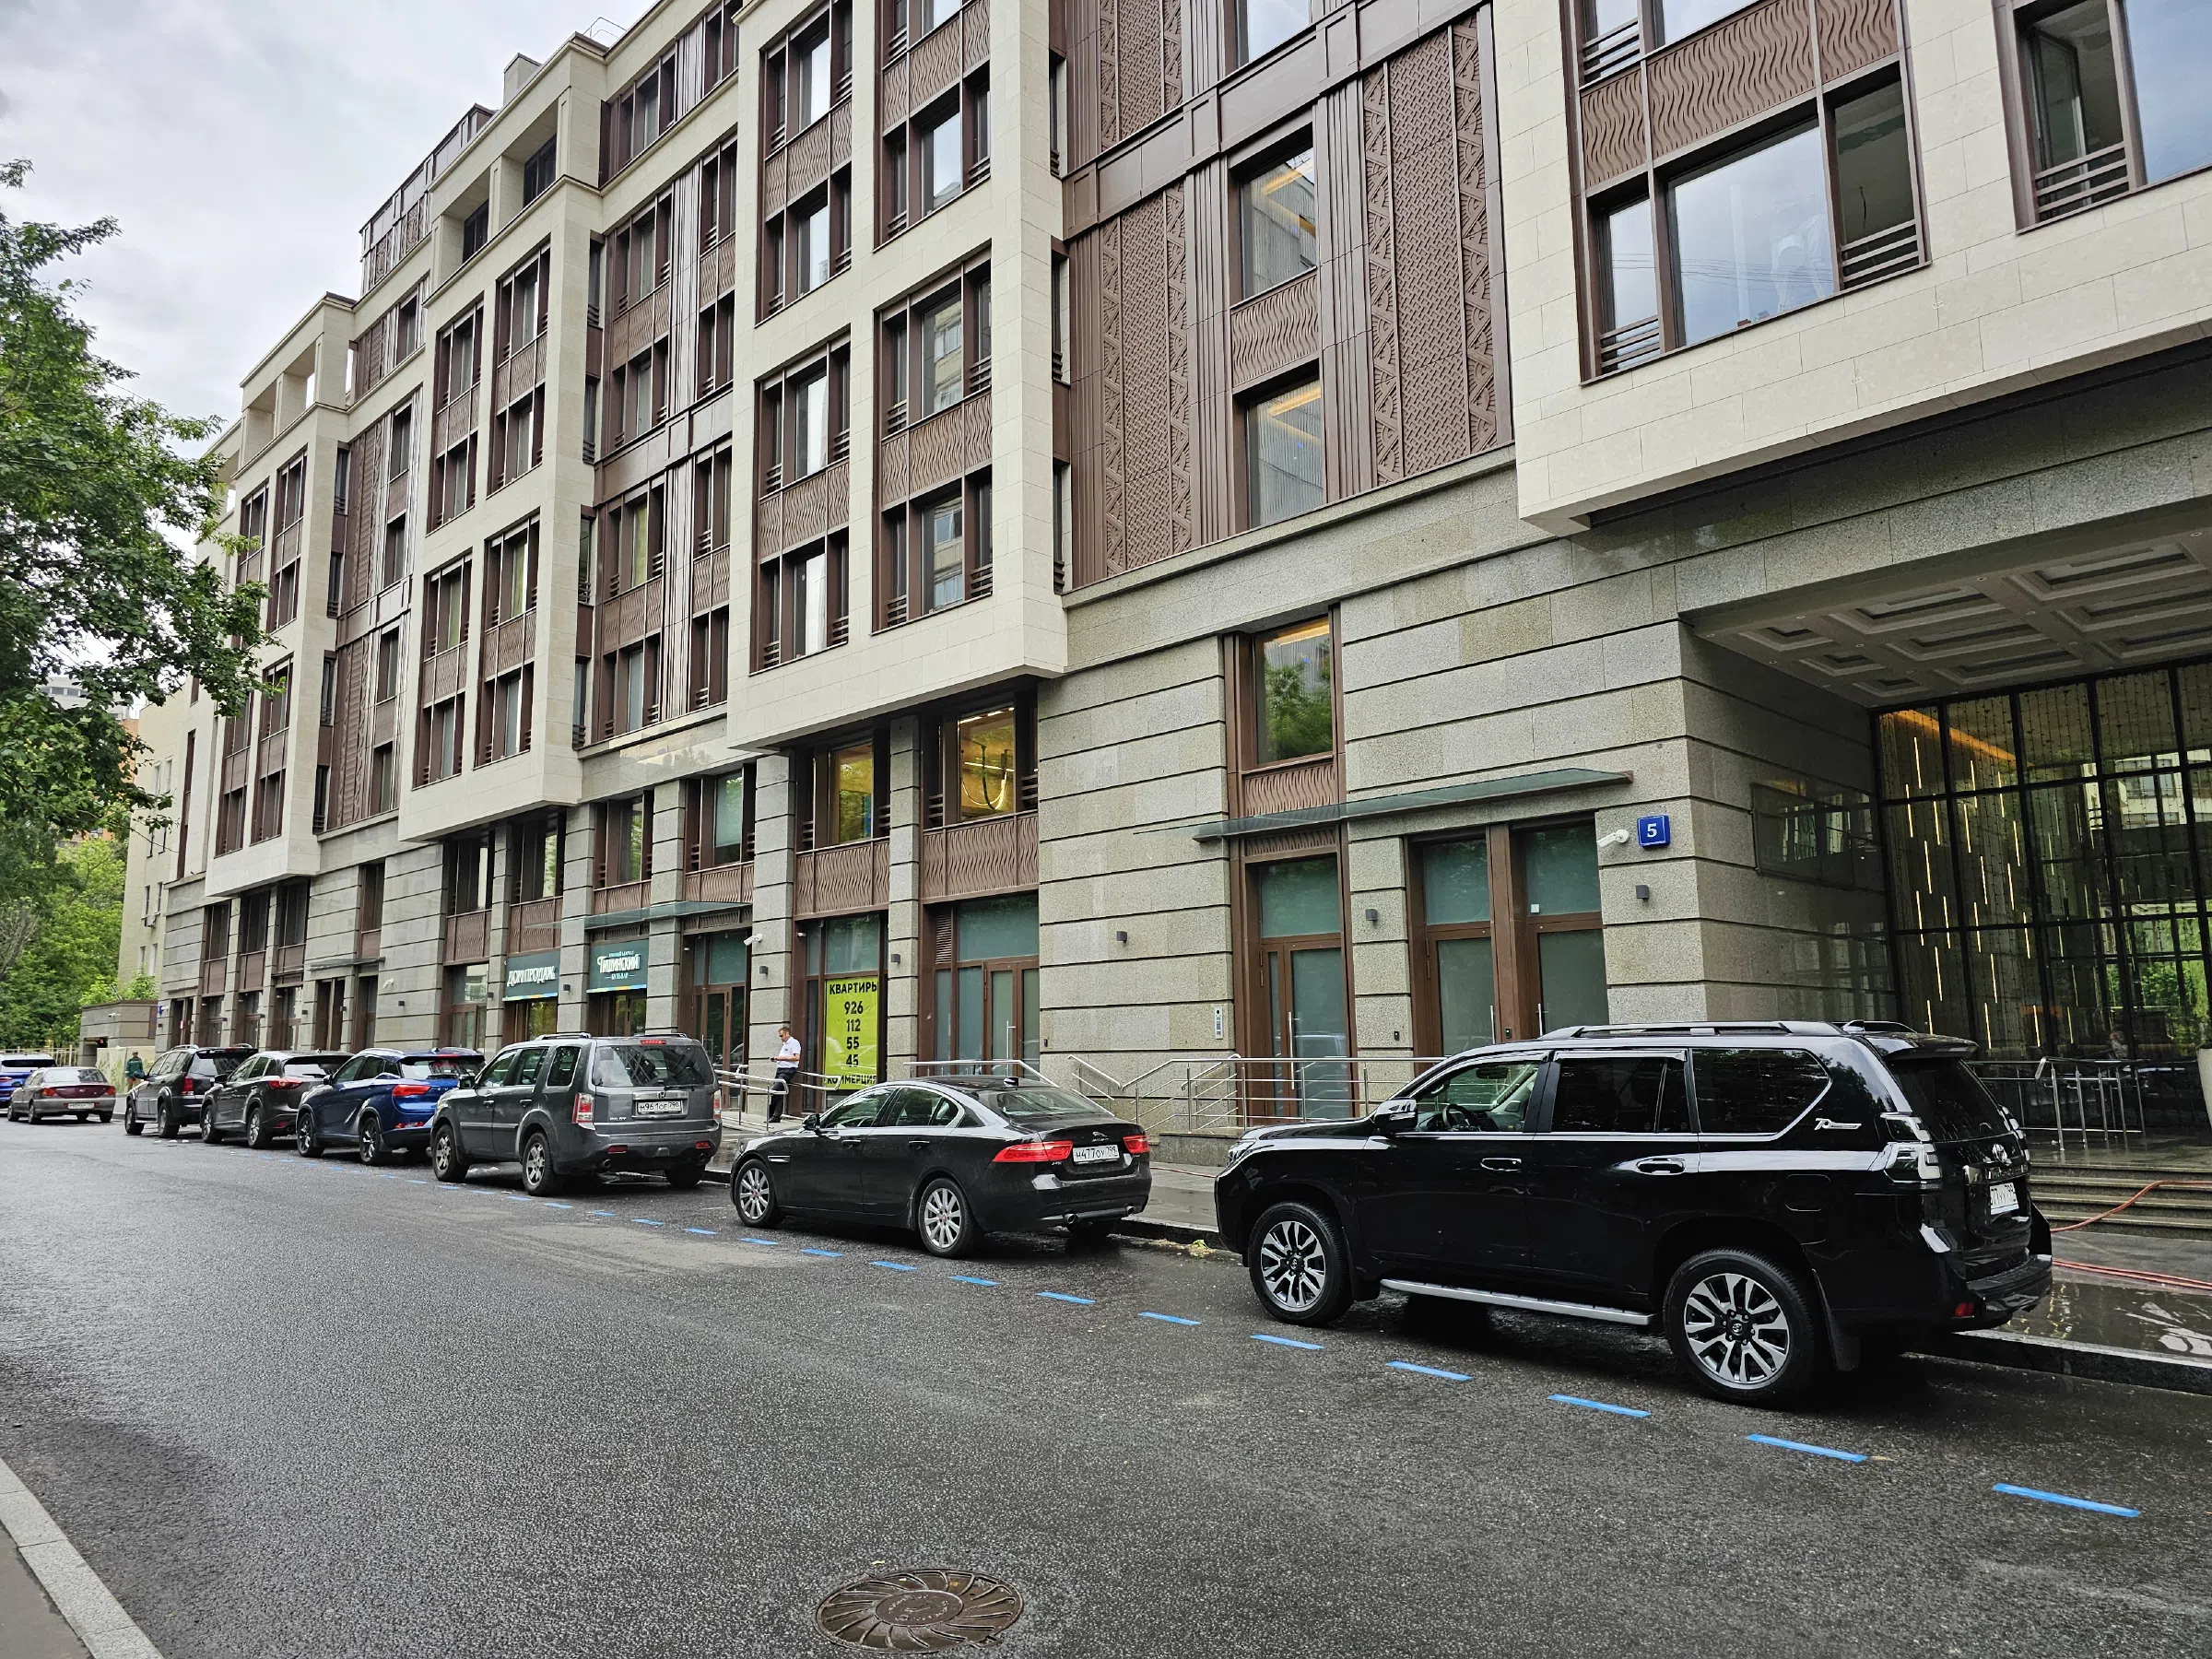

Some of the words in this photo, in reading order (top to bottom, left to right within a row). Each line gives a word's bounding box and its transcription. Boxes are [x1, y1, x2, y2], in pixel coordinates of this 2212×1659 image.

[1647, 823, 1657, 838] 5
[844, 1001, 864, 1015] 926
[846, 1018, 861, 1032] 112
[846, 1036, 860, 1050] 55
[845, 1053, 859, 1068] 45
